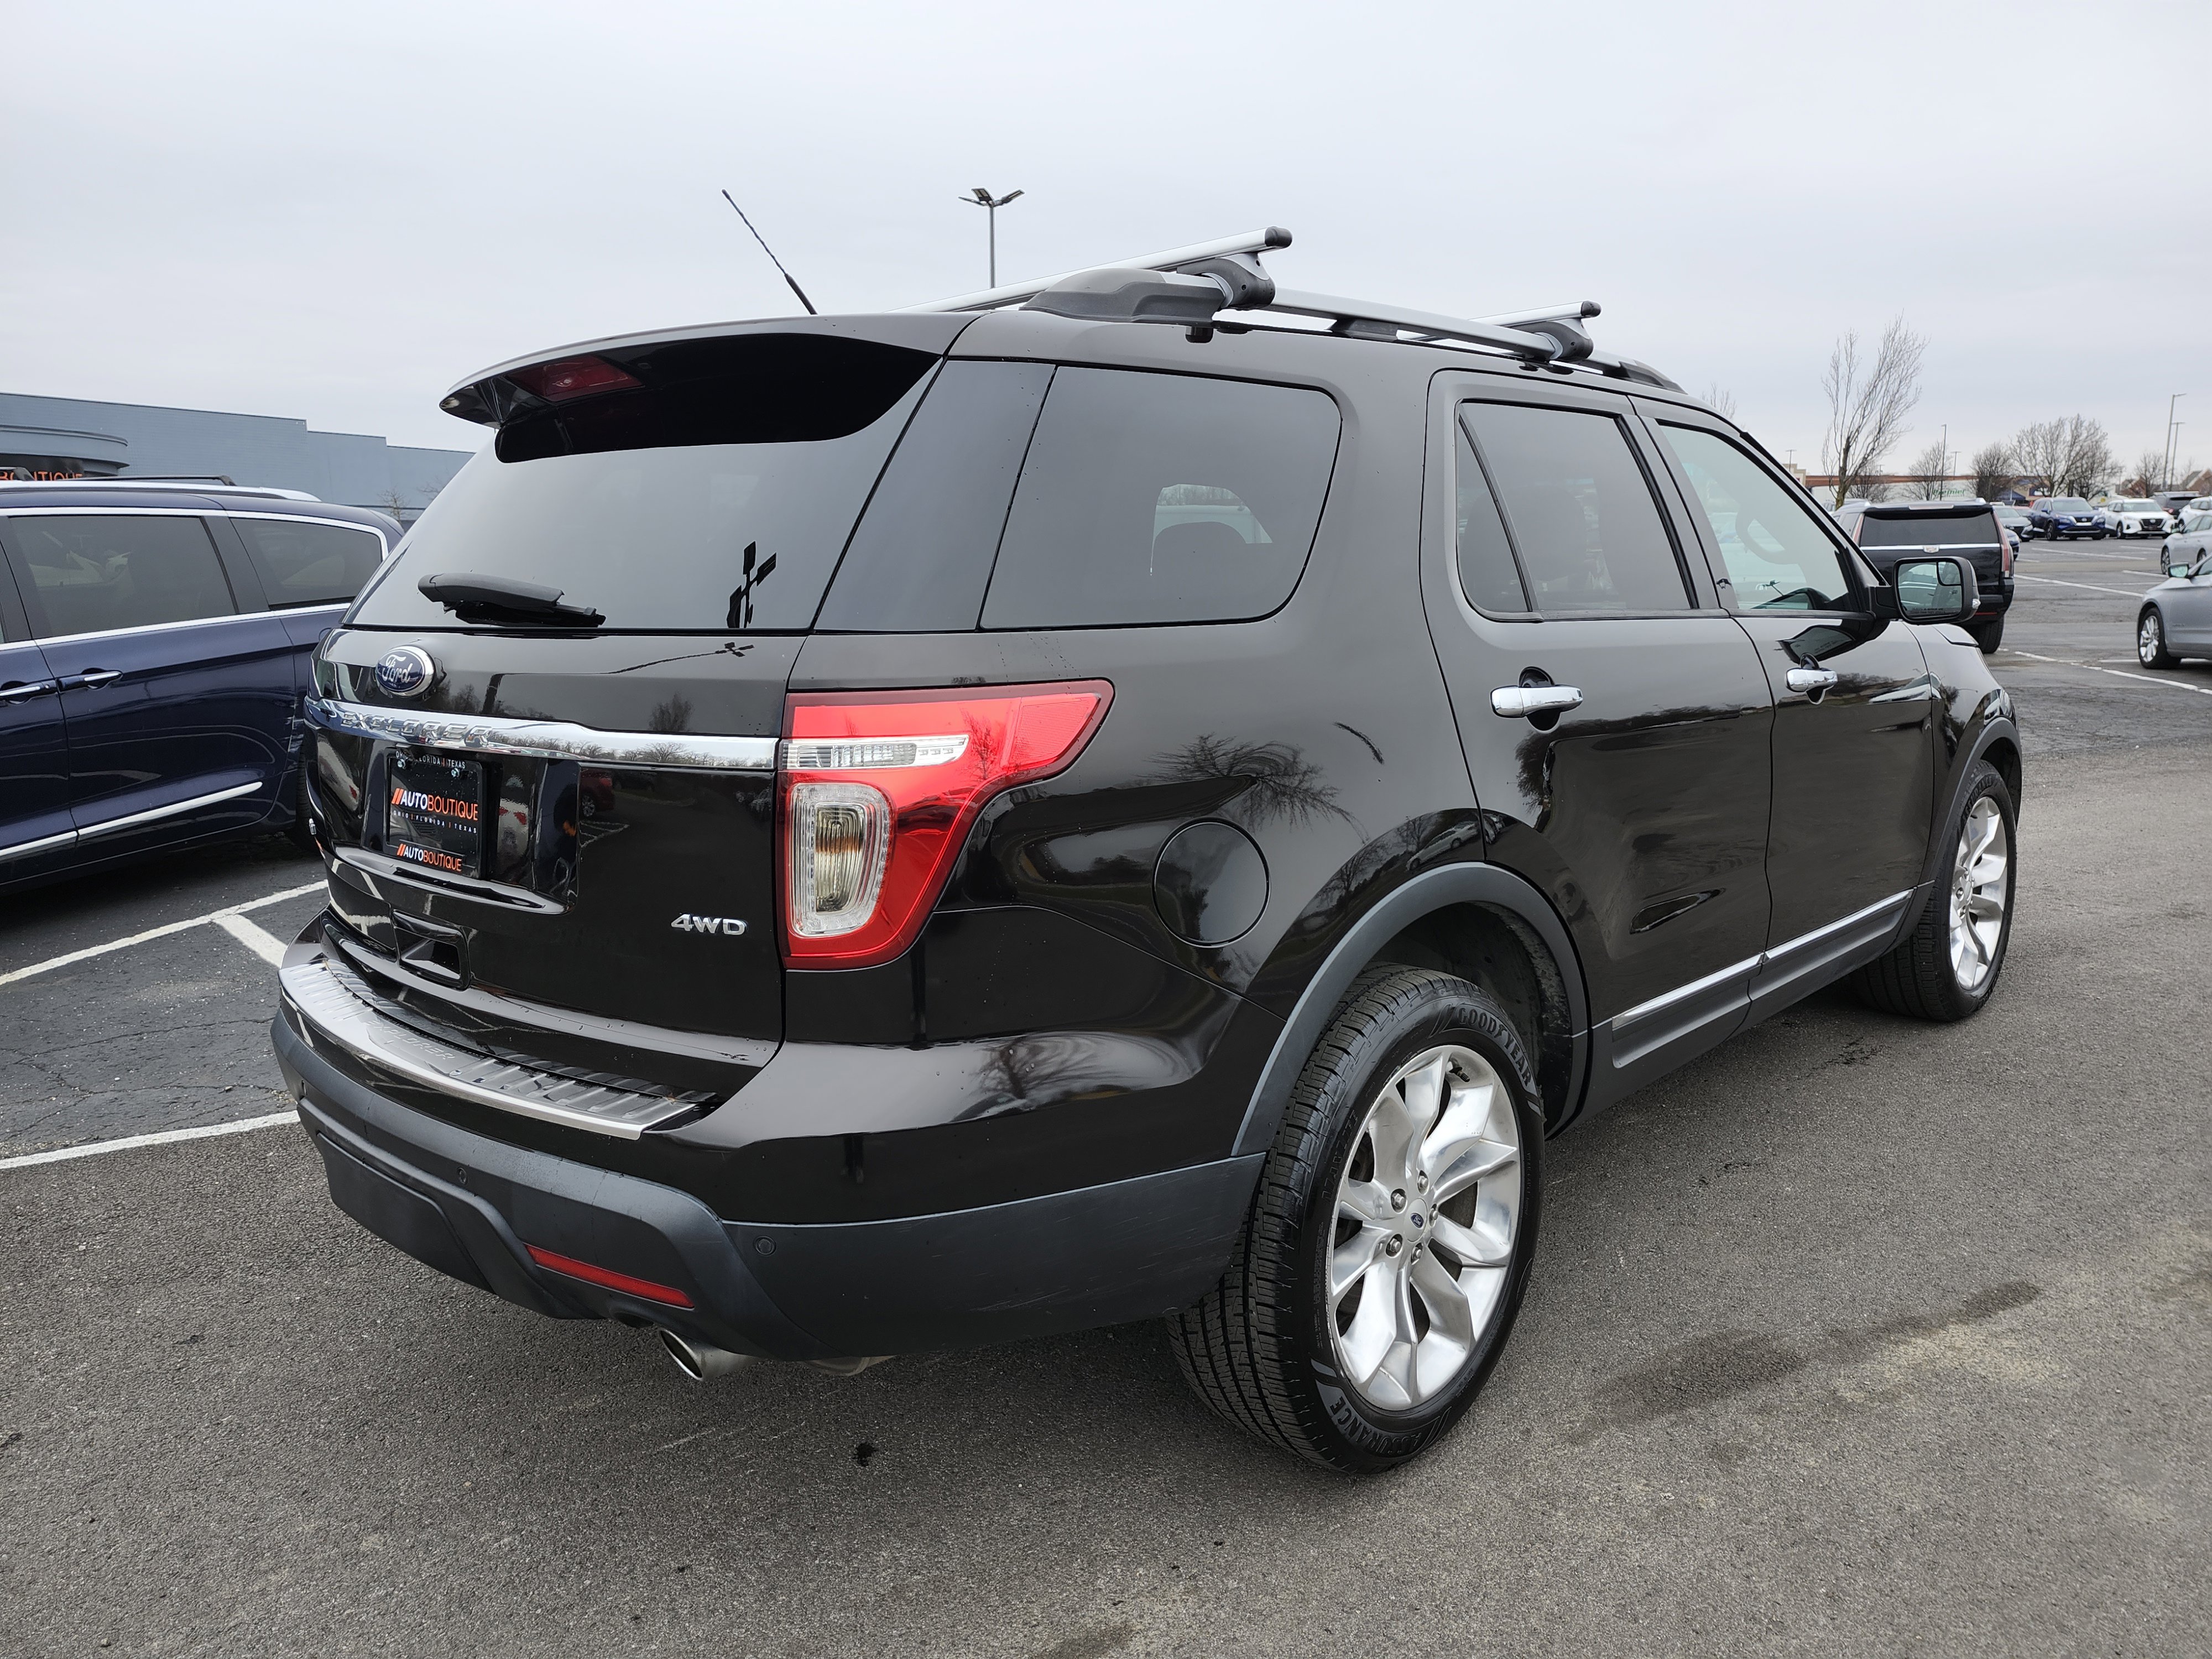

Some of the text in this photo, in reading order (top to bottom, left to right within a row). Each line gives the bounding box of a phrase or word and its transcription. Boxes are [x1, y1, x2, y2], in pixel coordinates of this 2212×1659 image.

[382, 654, 419, 684] Ford
[341, 712, 493, 748] EXPLORER
[415, 755, 441, 765] LORIDA
[448, 759, 465, 769] TEXAS
[393, 810, 477, 833] OHIO FLORIDA TEXAS
[671, 914, 747, 935] 4WD
[363, 1020, 456, 1060] EXPLORER
[1458, 1007, 1532, 1086] GOODYEAR
